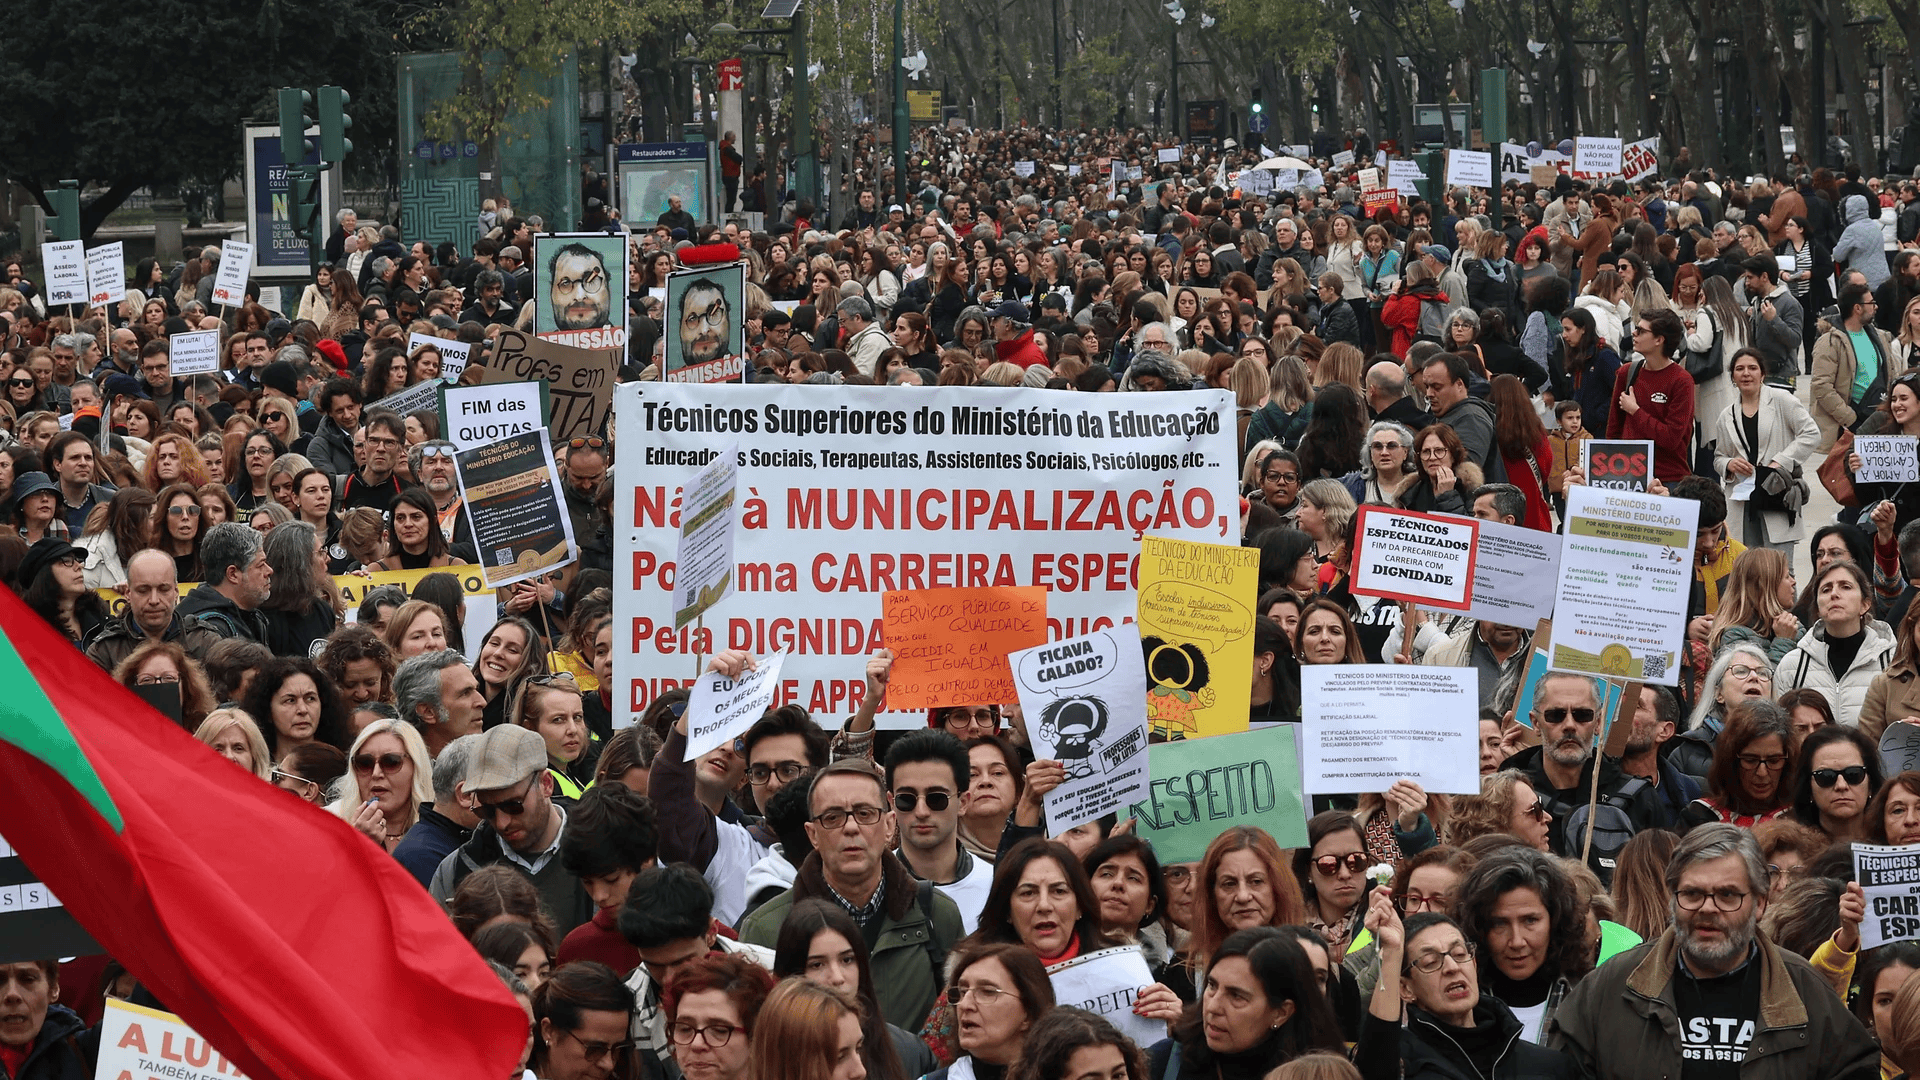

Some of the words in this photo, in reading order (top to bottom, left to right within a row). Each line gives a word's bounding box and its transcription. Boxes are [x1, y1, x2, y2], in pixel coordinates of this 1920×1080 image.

[631, 148, 676, 157] Restauradores
[1597, 142, 1606, 150] DÁ
[1606, 143, 1621, 151] ASAS
[1623, 145, 1641, 161] EM
[1366, 191, 1396, 202] RESPEITO
[462, 399, 491, 415] FIM
[497, 399, 526, 412] das
[643, 401, 758, 433] Técnicos
[764, 403, 907, 437] Superiores
[913, 406, 945, 435] do
[951, 406, 1073, 437] Ministério
[1077, 410, 1105, 438] da
[1108, 406, 1220, 442] Educação
[459, 421, 532, 442] QUOTAS
[479, 443, 509, 457] TÉCNICOS
[510, 440, 519, 448] DO
[1860, 441, 1891, 453] CHEGA!
[1895, 442, 1914, 455] NÃO
[466, 453, 502, 470] MINISTÉRIO
[503, 444, 536, 460] EDUCAÇÃO
[750, 449, 817, 470] Sociais,
[820, 449, 923, 470] Terapeutas,
[926, 450, 1022, 469] Assistentes
[1026, 450, 1090, 471] Sociais,
[1093, 451, 1179, 471] Psicólogos,
[1182, 452, 1204, 468] etc
[1591, 452, 1647, 477] SOS
[1866, 456, 1915, 467] CAMISOLA
[1873, 470, 1901, 480] AMOR
[1908, 470, 1916, 480] O
[1592, 479, 1645, 492] ESCOLA
[742, 487, 768, 530] à
[787, 479, 1229, 541] MUNICIPALIZAÇÃO,
[1605, 496, 1647, 510] TÉCNICOS
[1650, 502, 1662, 512] DO
[1582, 506, 1632, 520] MINISTÉRIO
[1634, 512, 1681, 526] EDUCAÇÃO
[1390, 517, 1449, 535] TÉCNICOS
[1367, 528, 1469, 551] ESPECIALIZADOS
[1620, 532, 1641, 541] VOSSOS
[1145, 537, 1186, 559] TÉCNICOS
[1190, 544, 1201, 561] DO
[1204, 546, 1259, 569] MINISTÉRIO
[1372, 541, 1387, 549] FIM
[1388, 543, 1400, 551] DA
[1402, 545, 1459, 561] PRECARIEDADE
[1570, 543, 1598, 553] Direitos
[1599, 546, 1648, 559] fundamentais
[1385, 554, 1423, 566] CARREIRA
[1425, 560, 1443, 570] COM
[1631, 563, 1644, 571] são
[1645, 565, 1681, 575] essenciais
[811, 552, 1017, 593] CARREIRA
[1159, 558, 1175, 577] DA
[1176, 561, 1233, 585] EDUCAÇÃO
[1372, 564, 1453, 586] DIGNIDADE
[1567, 566, 1608, 577] Consolidação
[1574, 575, 1608, 585] mobilidade
[1616, 573, 1634, 581] Vagas
[1617, 581, 1639, 589] quadro
[1651, 585, 1677, 593] especial
[1652, 578, 1678, 586] Carreira
[889, 595, 910, 605] PARA
[1021, 600, 1040, 613] DE
[1187, 595, 1232, 611] inclusivas
[949, 616, 1034, 632] QUALIDADE
[632, 616, 713, 655] Pela
[1574, 628, 1587, 636] Não
[1593, 631, 1624, 641] avaliação
[1638, 637, 1664, 645] quotas!
[888, 643, 956, 660] DECIDIR
[969, 642, 989, 655] EM
[1038, 640, 1094, 665] FICAVA
[1037, 655, 1104, 683] CALADO?
[712, 680, 733, 692] EU
[736, 665, 771, 689] APOIO
[888, 683, 920, 696] PELO
[927, 678, 980, 693] CONTROLO
[715, 700, 730, 714] OS
[732, 682, 761, 704] MEUS
[926, 695, 939, 705] DA
[951, 688, 1017, 705] EDUCAÇÃO
[693, 692, 770, 738] PROFESSORES
[1102, 729, 1141, 761] PROFESSORES
[1112, 754, 1122, 766] EM
[1121, 743, 1138, 760] LUTA!
[1064, 792, 1075, 801] SEU
[1077, 782, 1106, 796] EDUCANDO
[1106, 769, 1137, 785] MERECESSE
[1054, 807, 1074, 821] PORQUE
[1075, 803, 1083, 812] SÓ
[1085, 799, 1099, 808] PODE
[1101, 795, 1111, 803] SER
[1112, 783, 1140, 798] ATRIBUÍDO
[1129, 759, 1276, 836] RESPEITO
[1860, 855, 1917, 870] TÉCNICOS
[1871, 871, 1879, 884] E
[138, 1058, 198, 1080] TAMBÉM
